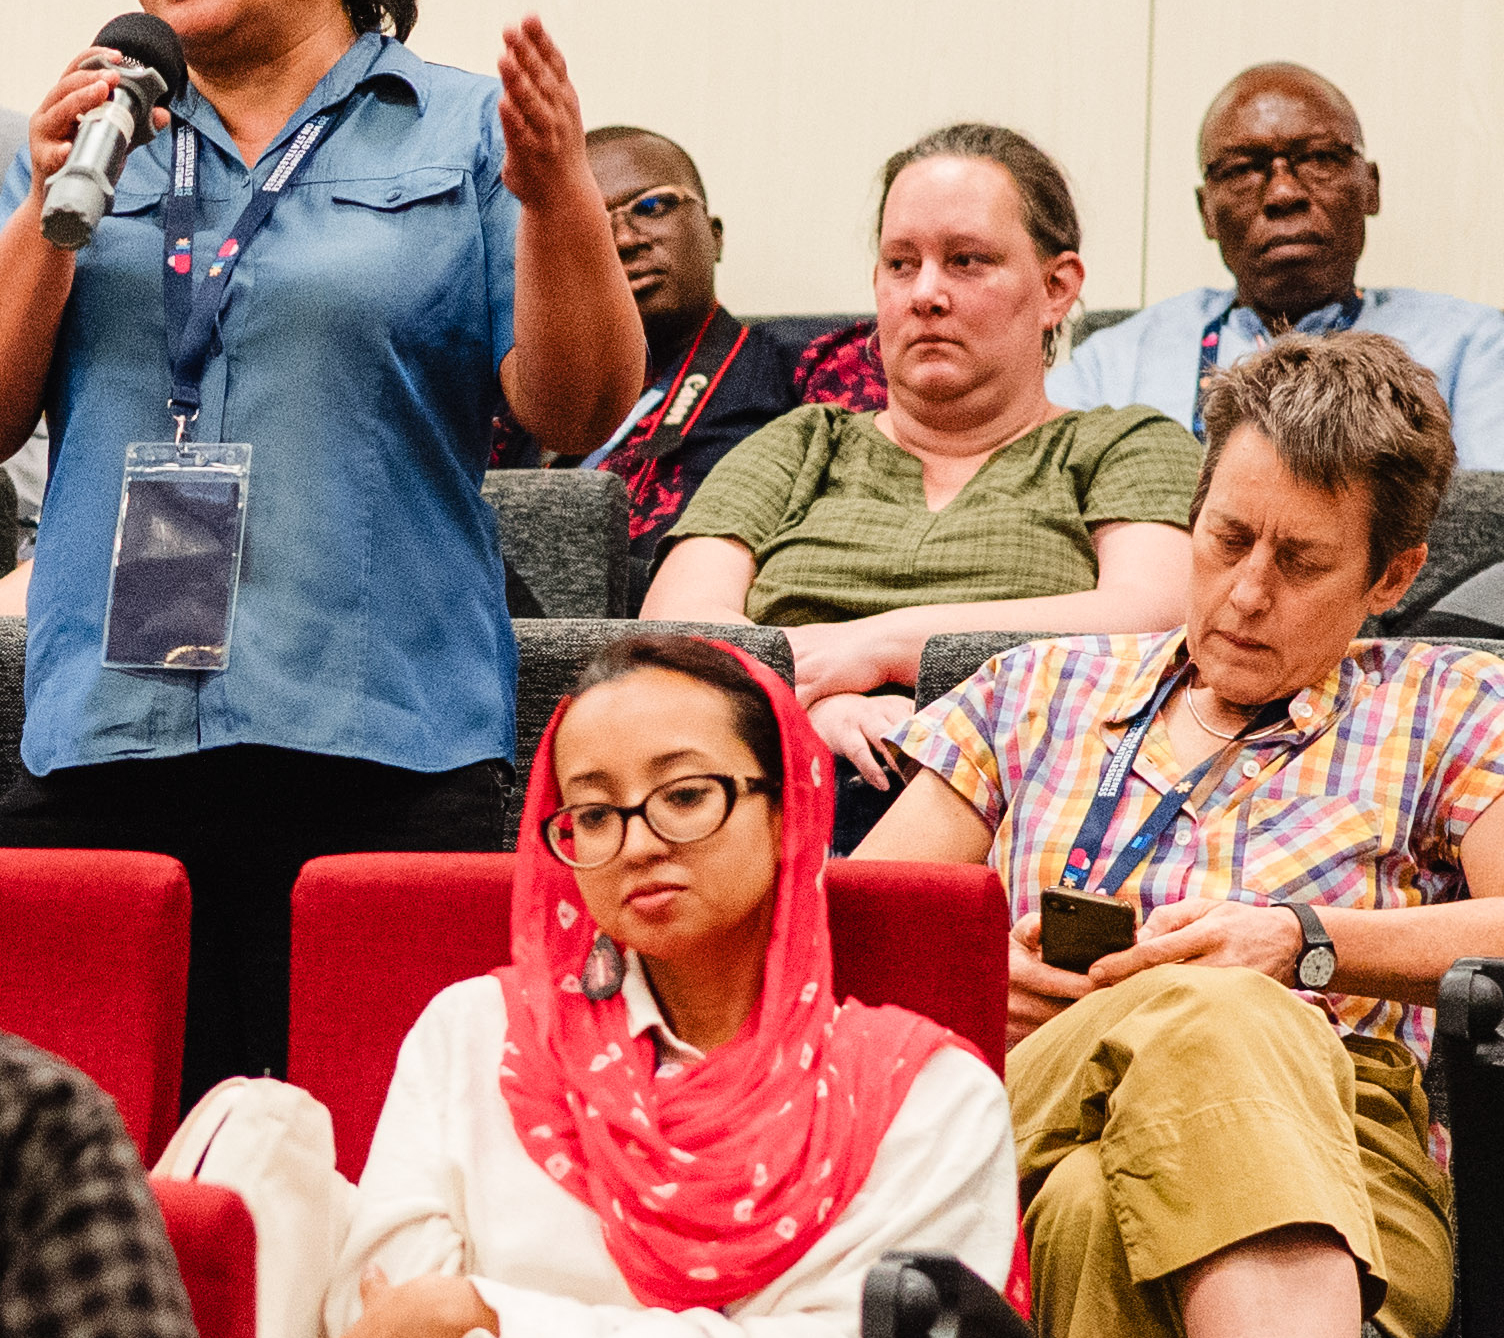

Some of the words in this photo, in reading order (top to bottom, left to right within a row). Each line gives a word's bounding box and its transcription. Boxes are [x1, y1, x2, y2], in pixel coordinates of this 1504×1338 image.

[270, 149, 305, 193] CONFERENCE
[1097, 738, 1130, 795] STATELESSNESS
[1107, 750, 1132, 797] CONFERENCE
